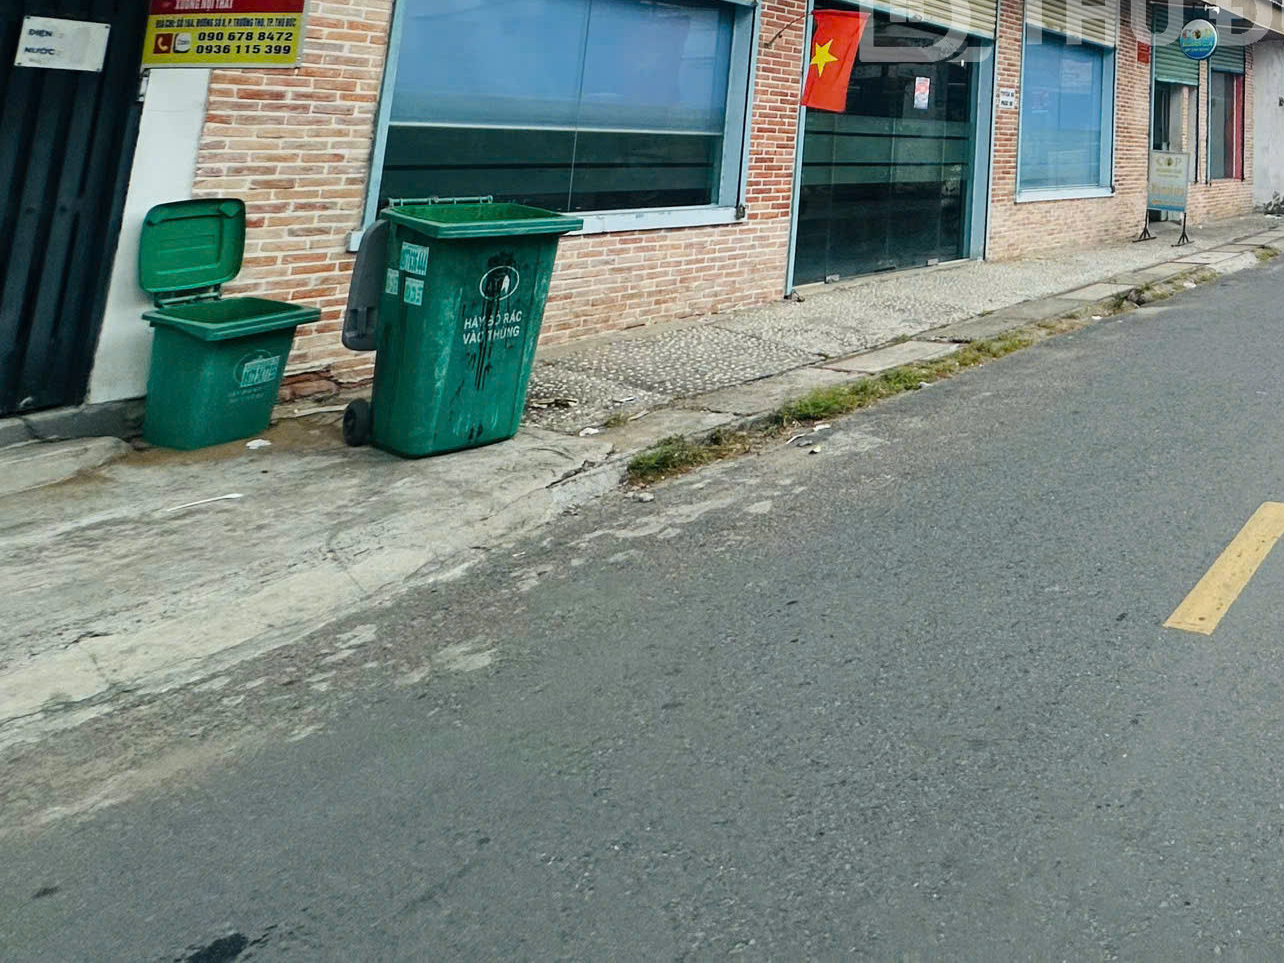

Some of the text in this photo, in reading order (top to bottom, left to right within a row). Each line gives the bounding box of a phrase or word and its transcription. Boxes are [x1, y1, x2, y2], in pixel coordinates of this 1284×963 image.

[198, 31, 293, 41] 090 678 8472
[195, 44, 291, 54] 0936 115 399
[503, 308, 523, 325] RÁC
[487, 325, 520, 341] THÙNG
